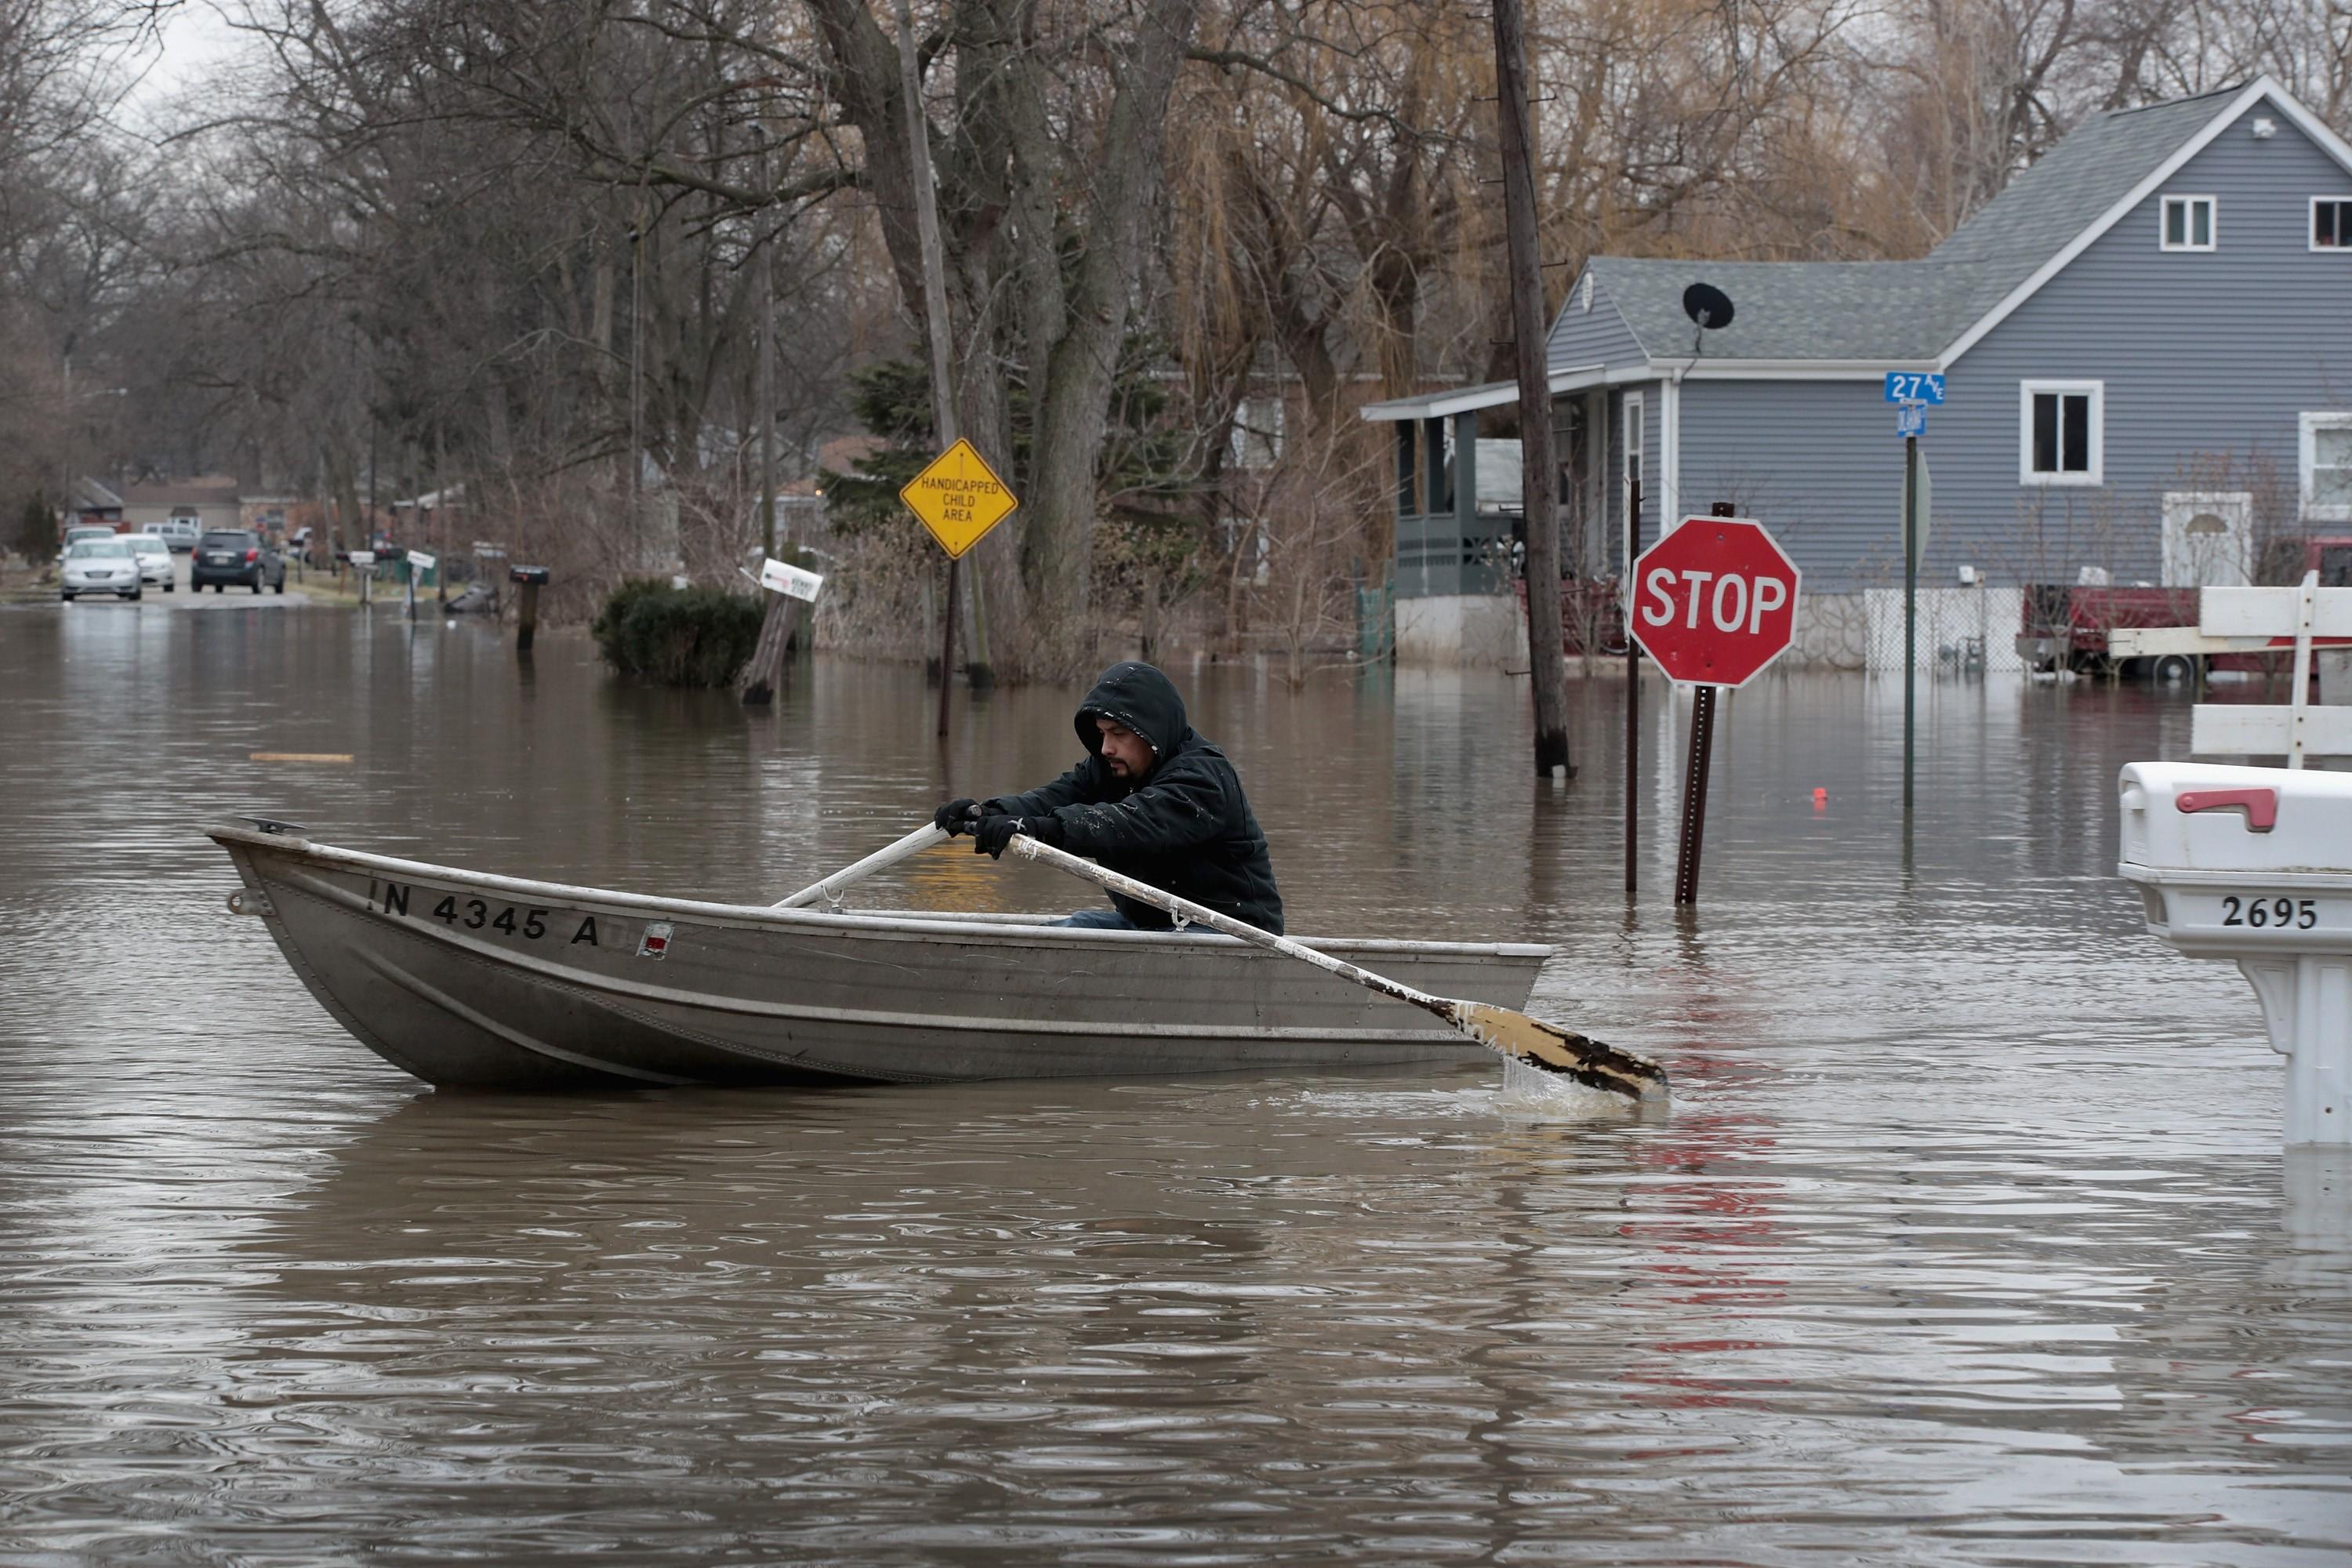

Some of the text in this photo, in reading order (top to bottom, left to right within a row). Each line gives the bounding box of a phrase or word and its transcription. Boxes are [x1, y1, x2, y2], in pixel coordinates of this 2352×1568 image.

[1892, 375, 1944, 400] 27 AVE
[921, 477, 999, 495] HANDICAPPED
[942, 493, 975, 507] CHILD
[942, 509, 973, 522] AREA
[1642, 567, 1787, 634] STOP
[367, 879, 599, 946] IN 4345 A
[2222, 895, 2318, 930] 2695
